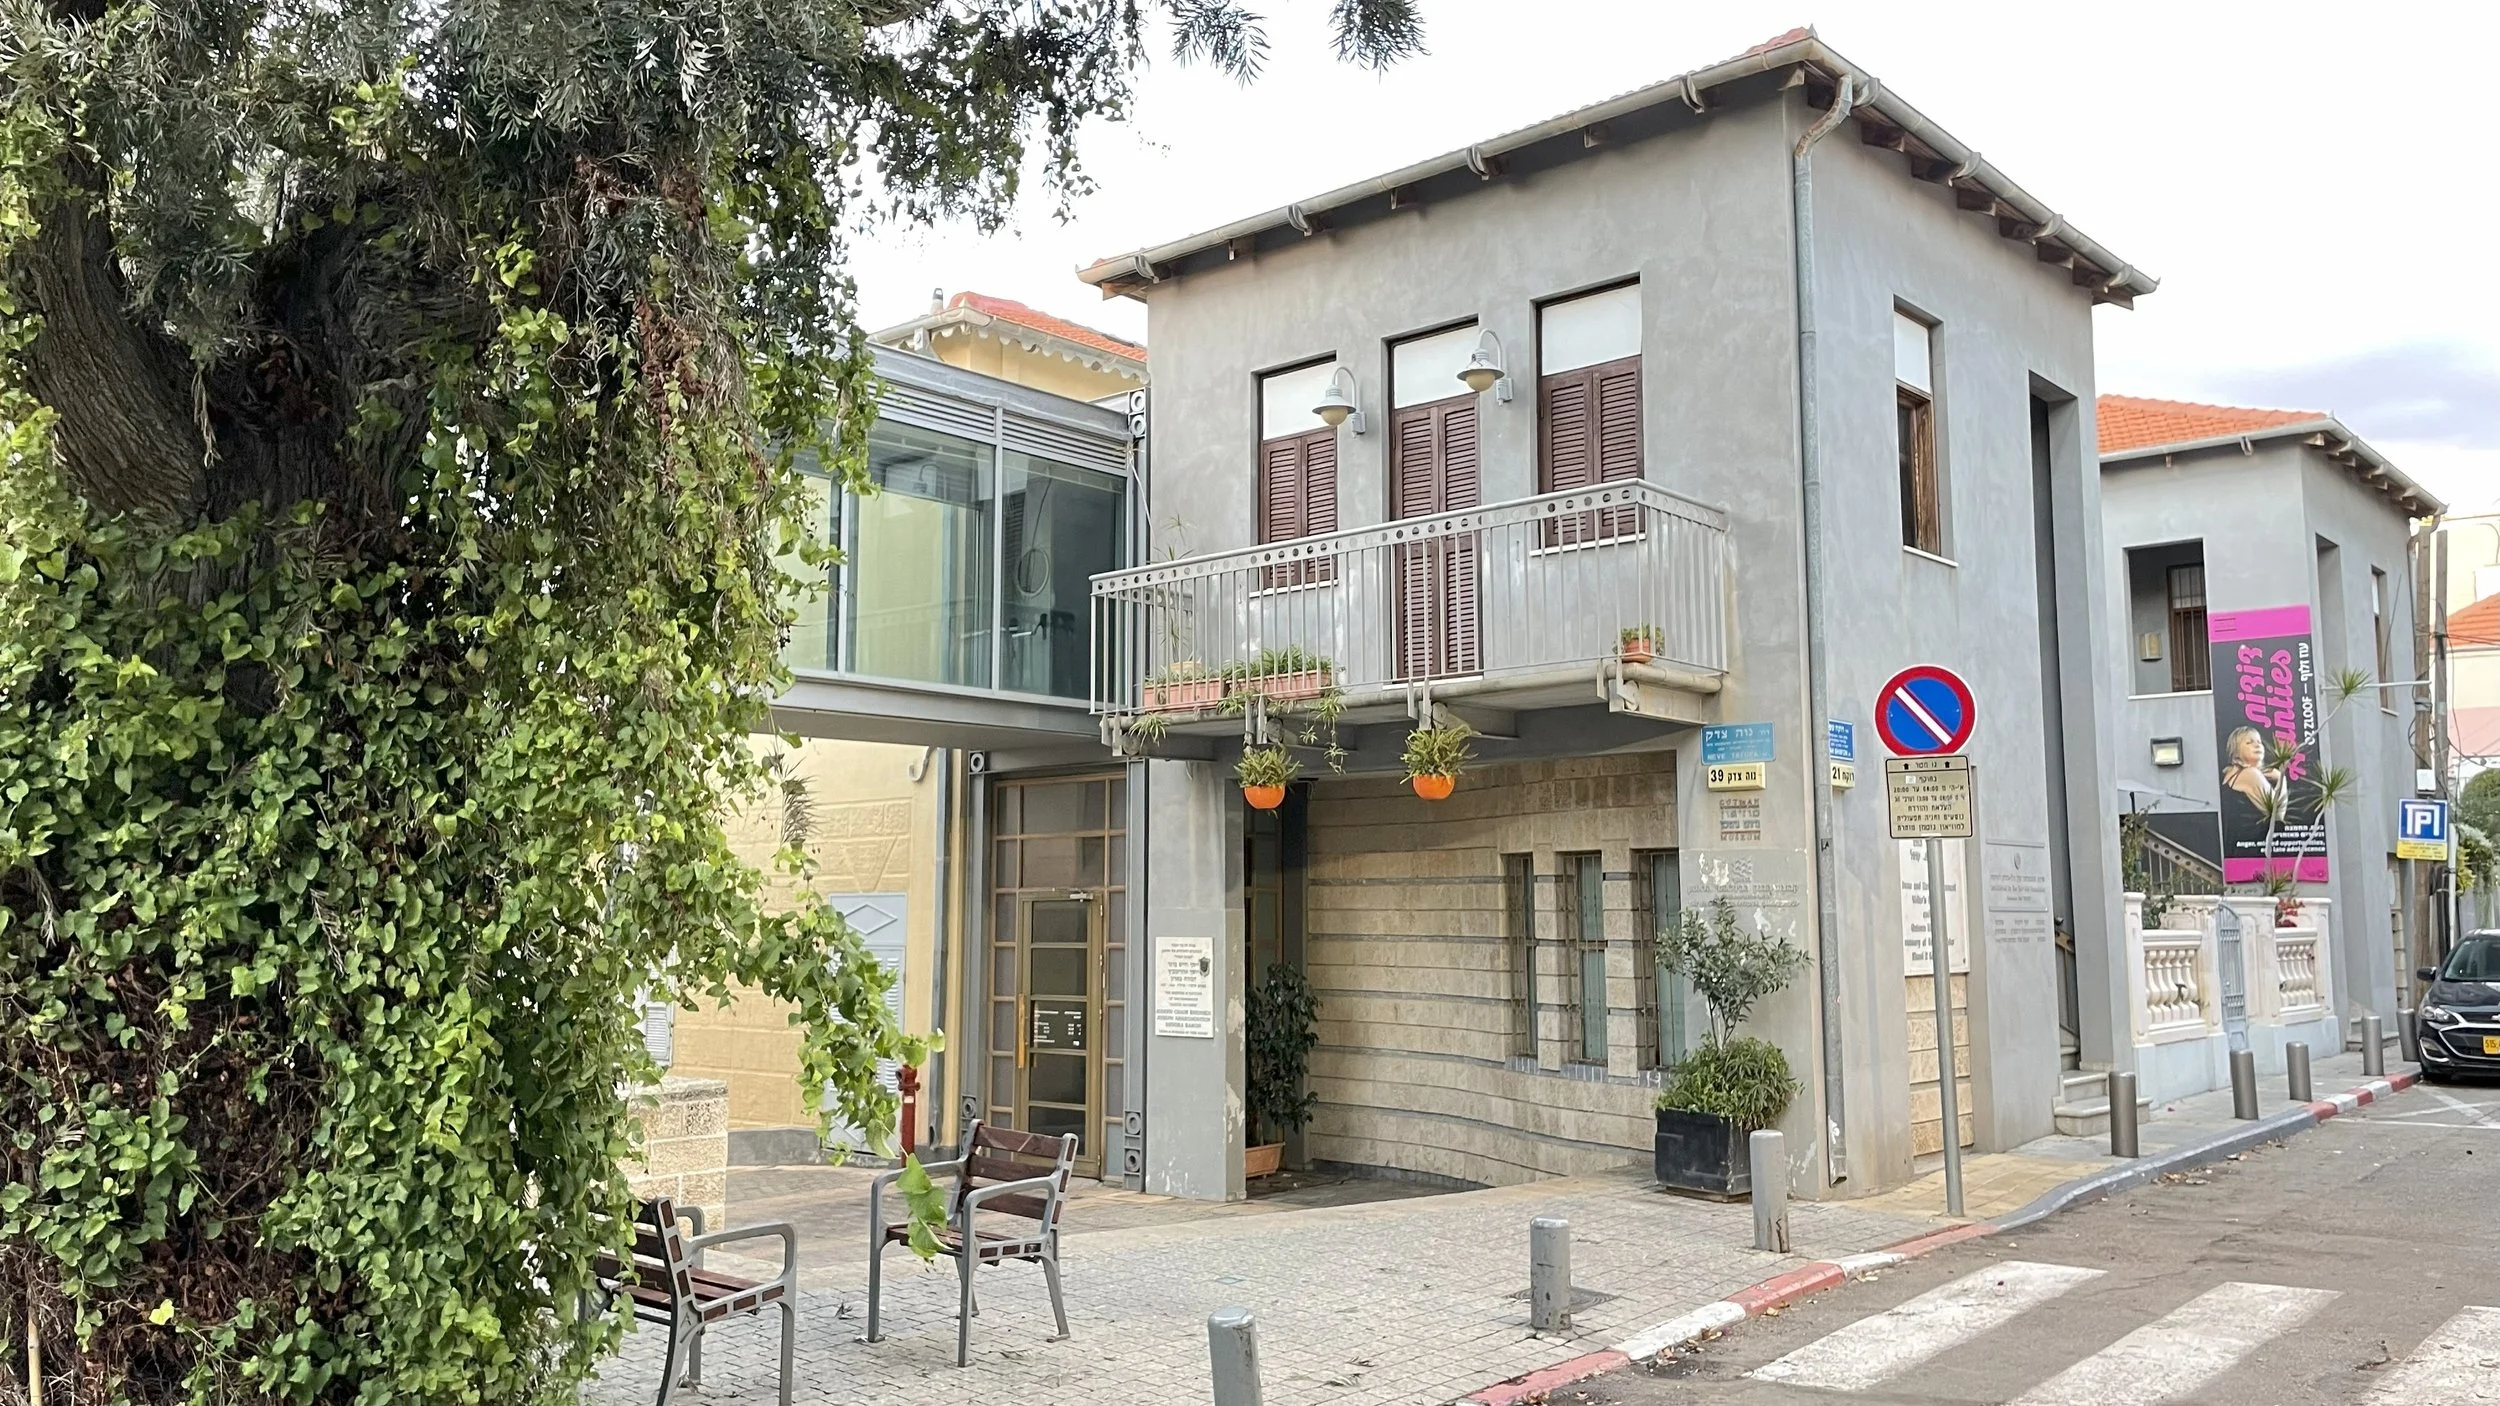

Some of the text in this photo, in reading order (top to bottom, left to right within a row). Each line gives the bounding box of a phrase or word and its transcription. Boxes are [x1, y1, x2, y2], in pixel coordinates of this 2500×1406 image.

[2301, 696, 2315, 729] ZLOOF
[1705, 729, 1728, 742] צדק
[1710, 769, 1757, 784] נוה צדק 39
[1832, 766, 1841, 780] 21
